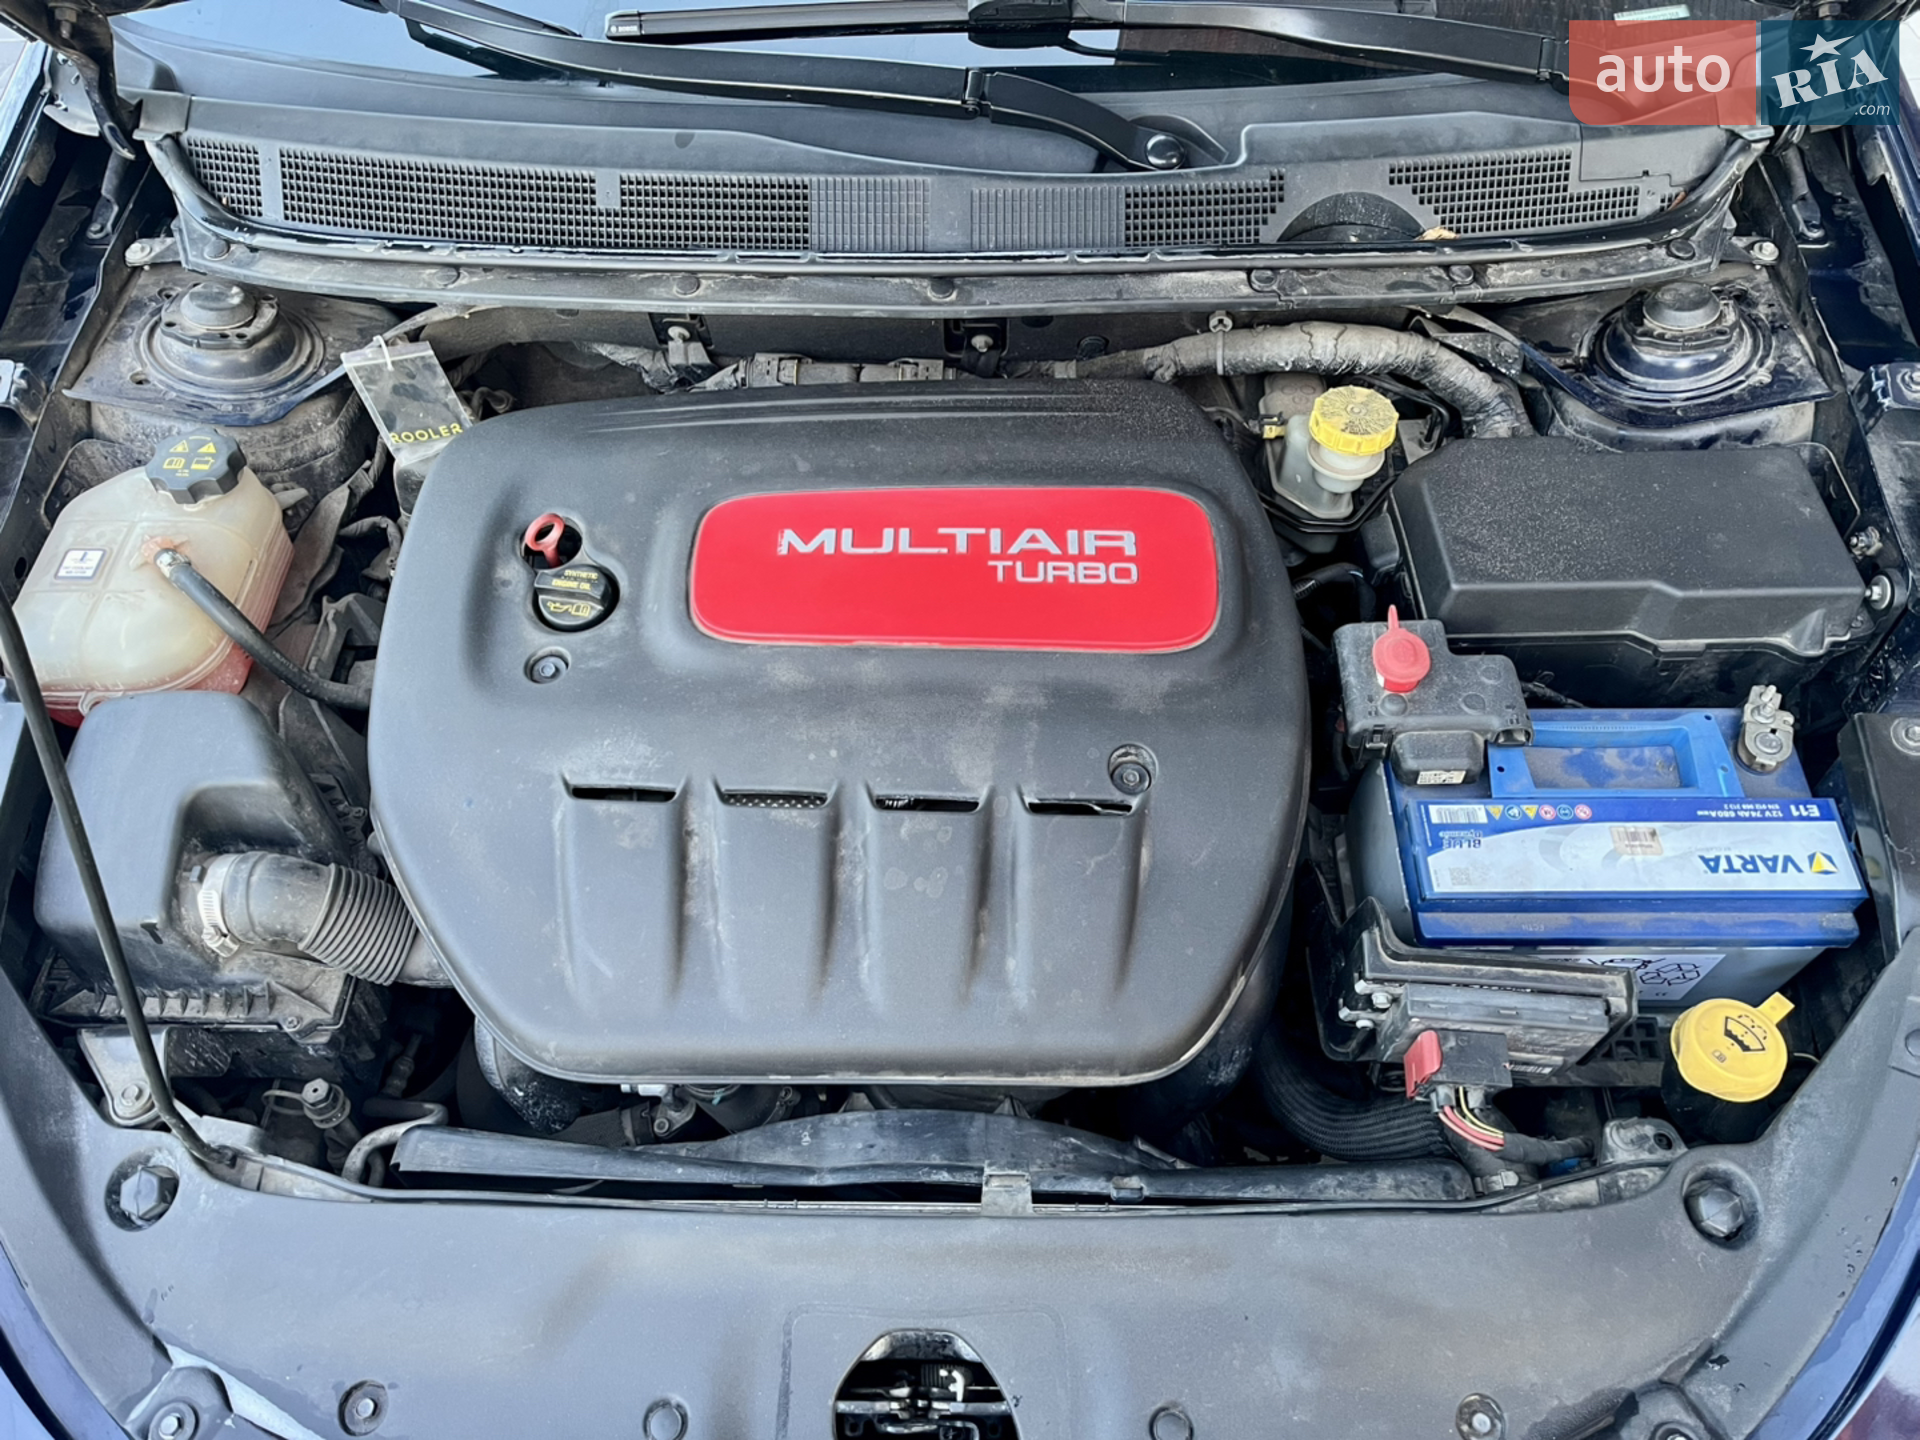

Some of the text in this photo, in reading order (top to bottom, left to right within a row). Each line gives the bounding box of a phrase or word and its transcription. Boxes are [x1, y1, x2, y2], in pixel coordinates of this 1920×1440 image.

[389, 422, 463, 444] ROOLER
[777, 527, 1137, 556] MULTIAIR
[987, 560, 1138, 584] TURBO
[1790, 804, 1821, 817] E11
[1442, 838, 1482, 849] BLUE
[1698, 855, 1804, 873] VARTA
